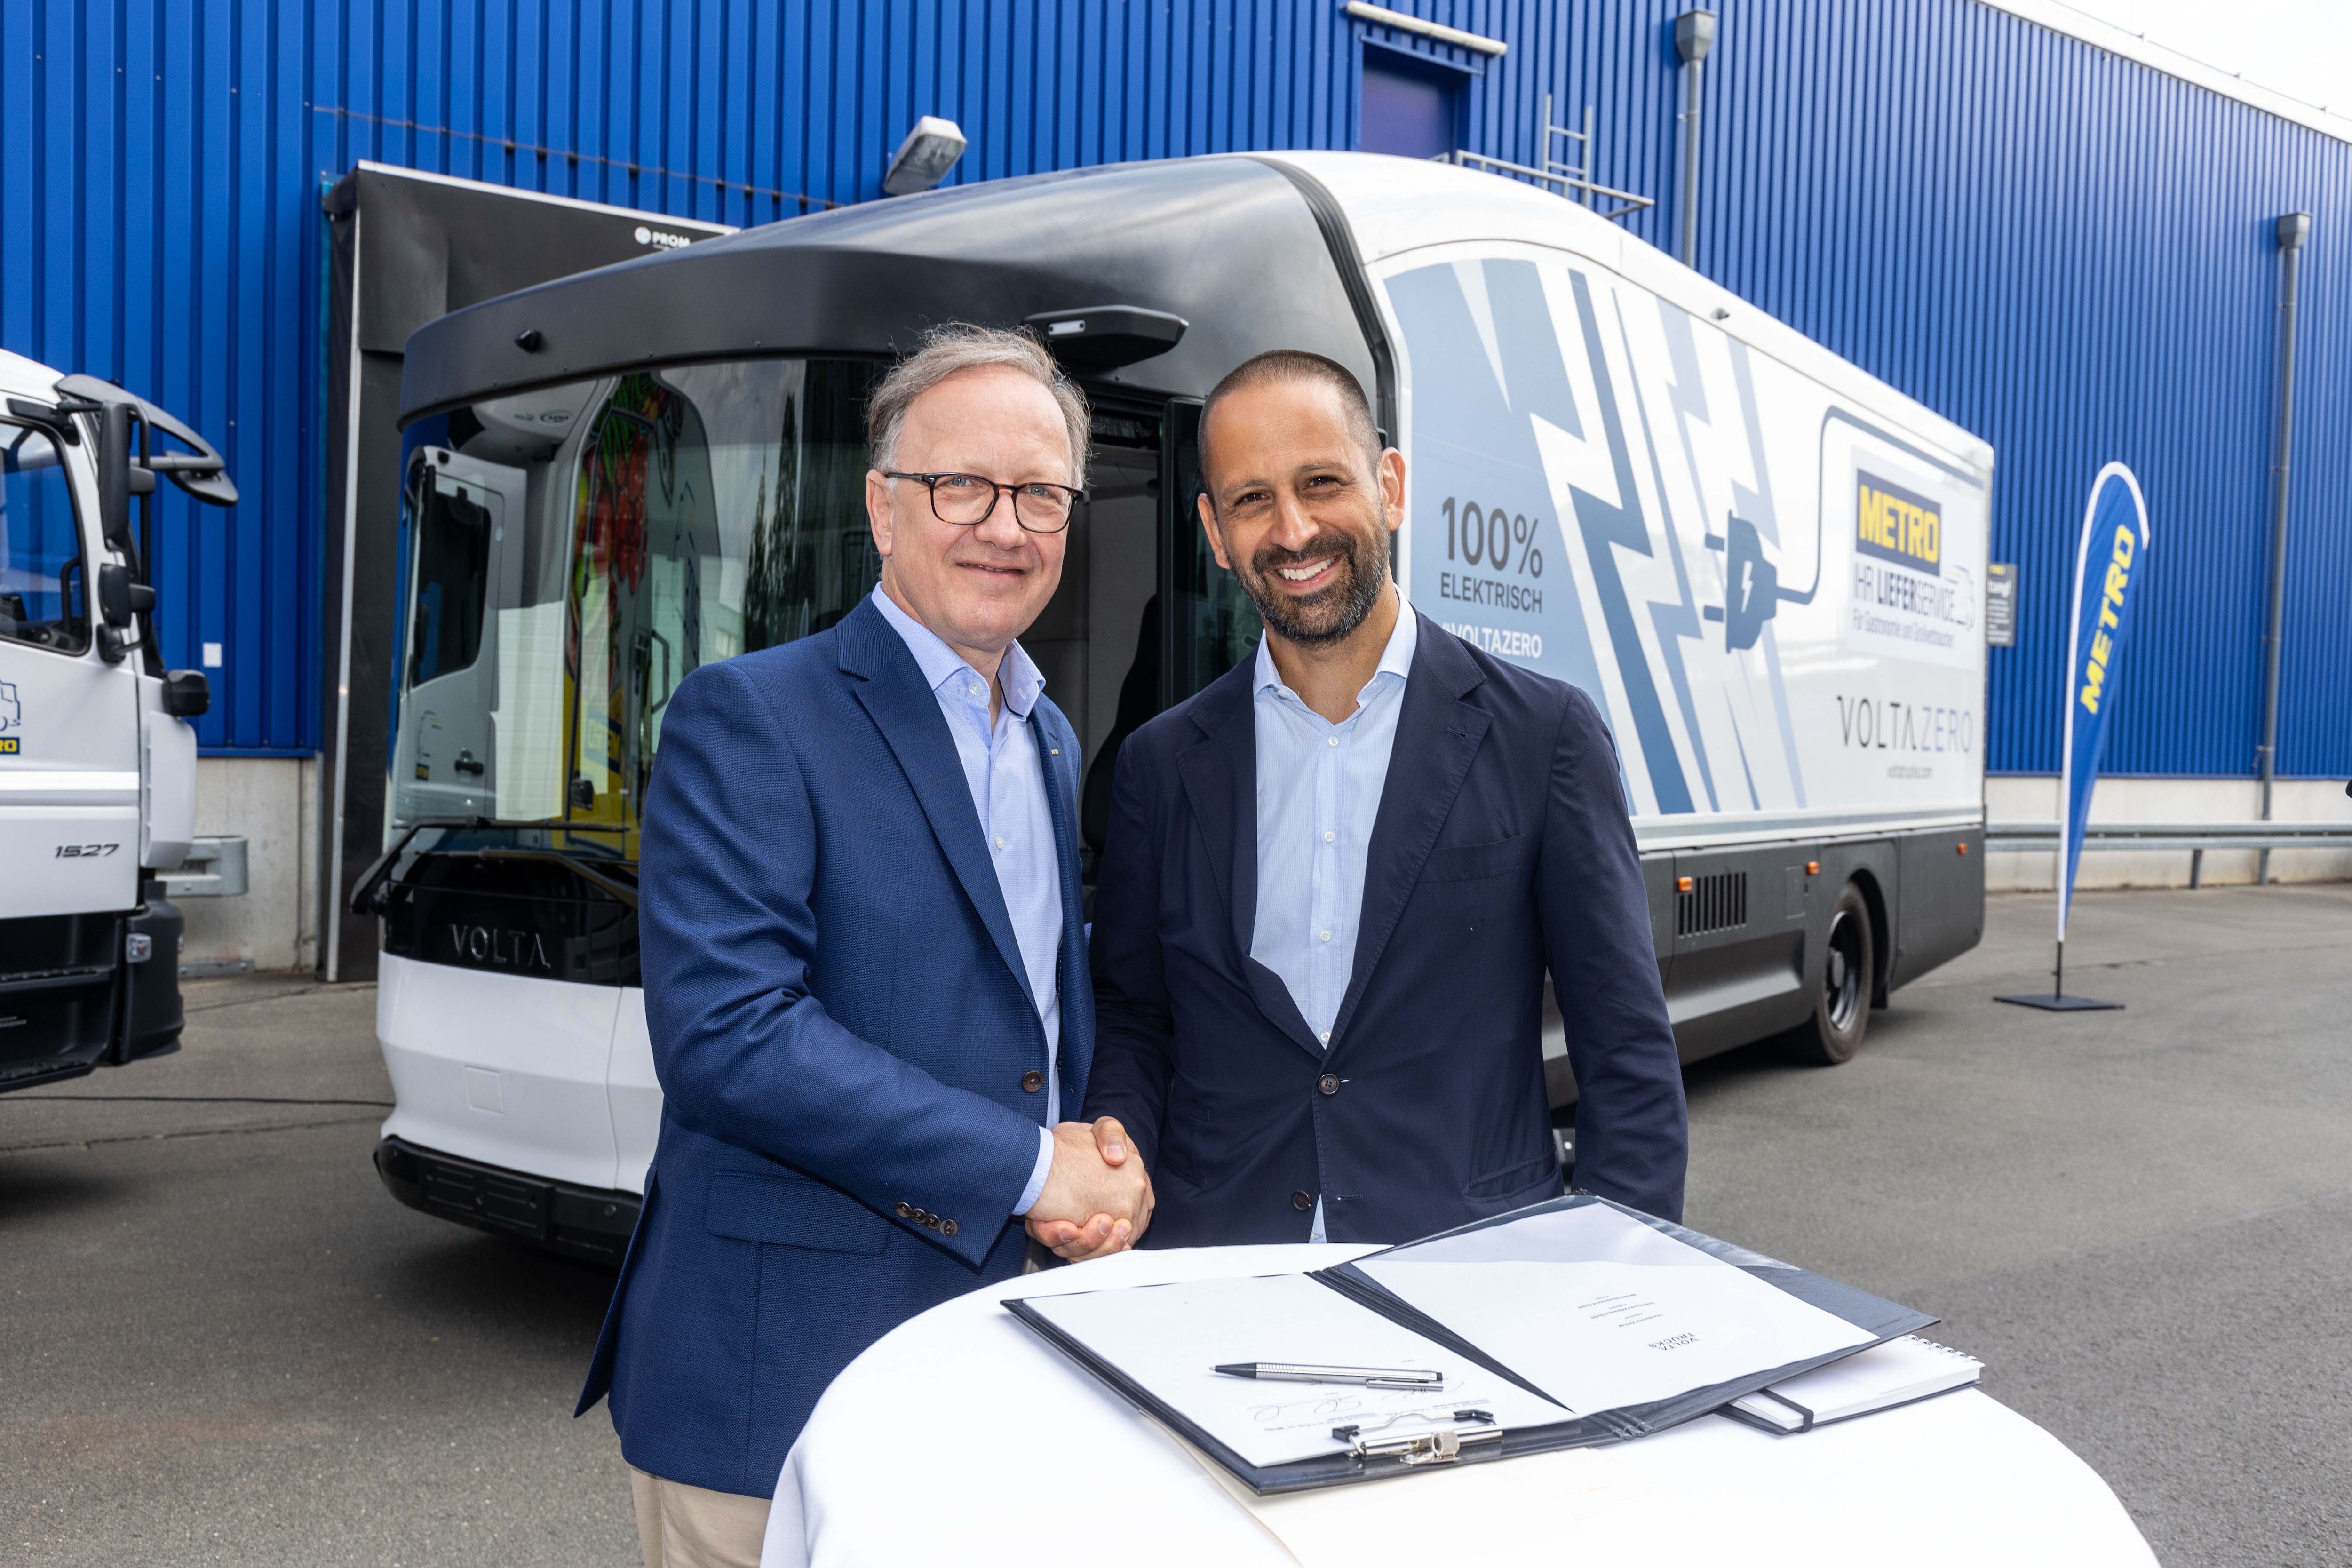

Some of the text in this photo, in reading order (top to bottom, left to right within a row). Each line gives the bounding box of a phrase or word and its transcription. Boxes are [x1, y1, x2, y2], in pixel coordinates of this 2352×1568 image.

[1442, 496, 1542, 578] 100%
[1859, 484, 1939, 564] METRO
[1440, 572, 1542, 614] ELEKTRISCH
[2080, 525, 2135, 714] METRO
[55, 844, 120, 858] 1527
[449, 923, 551, 969] VOLTA
[1648, 1332, 1696, 1348] TRUCKS
[1658, 1337, 1700, 1351] VOLTA
